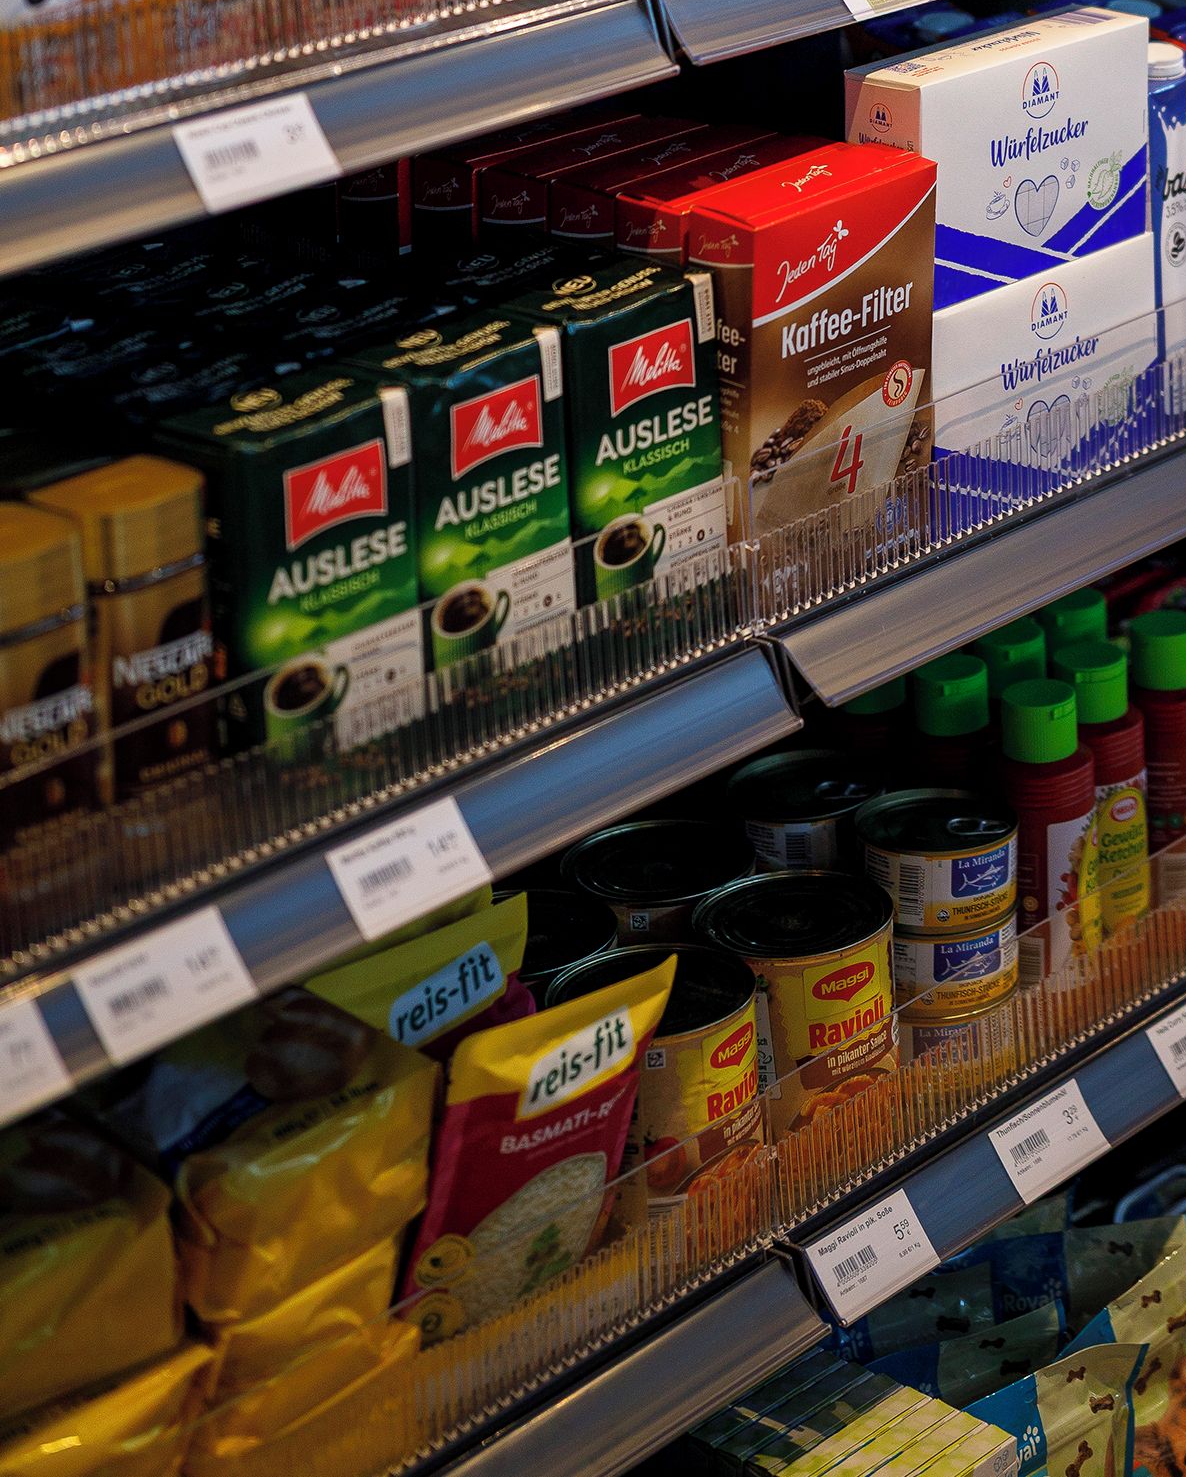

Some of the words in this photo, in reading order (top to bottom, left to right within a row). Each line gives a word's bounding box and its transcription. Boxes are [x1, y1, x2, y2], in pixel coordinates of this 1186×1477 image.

[1022, 90, 1060, 111] DIAMANT
[990, 117, 1089, 167] Würfelzucker
[775, 254, 817, 303] Jeden
[817, 232, 838, 272] Tag
[780, 280, 914, 360] Kaffee-Filter
[1030, 309, 1069, 333] DIAMANT
[619, 340, 683, 393] Melitta
[1000, 335, 1100, 392] Würfelzucker
[595, 394, 714, 467] AUSLESE
[622, 438, 691, 476] KLASSISCH
[830, 424, 865, 494] 4
[434, 453, 562, 532] AUSLESE
[266, 520, 408, 607] AUSLESE
[958, 858, 976, 870] La
[976, 849, 1006, 867] Miranda
[940, 944, 960, 955] La
[960, 935, 995, 953] Miranda
[394, 952, 495, 1043] reis-fit
[820, 966, 870, 997] Maggi
[807, 995, 885, 1050] Ravioli
[826, 1056, 837, 1069] in
[837, 1044, 869, 1068] pikanter
[869, 1029, 888, 1052] Sauce
[529, 1015, 628, 1105] reis-fit
[817, 1238, 838, 1257] Maggi
[837, 1227, 859, 1245] Ravioli
[876, 1205, 893, 1221] Soße
